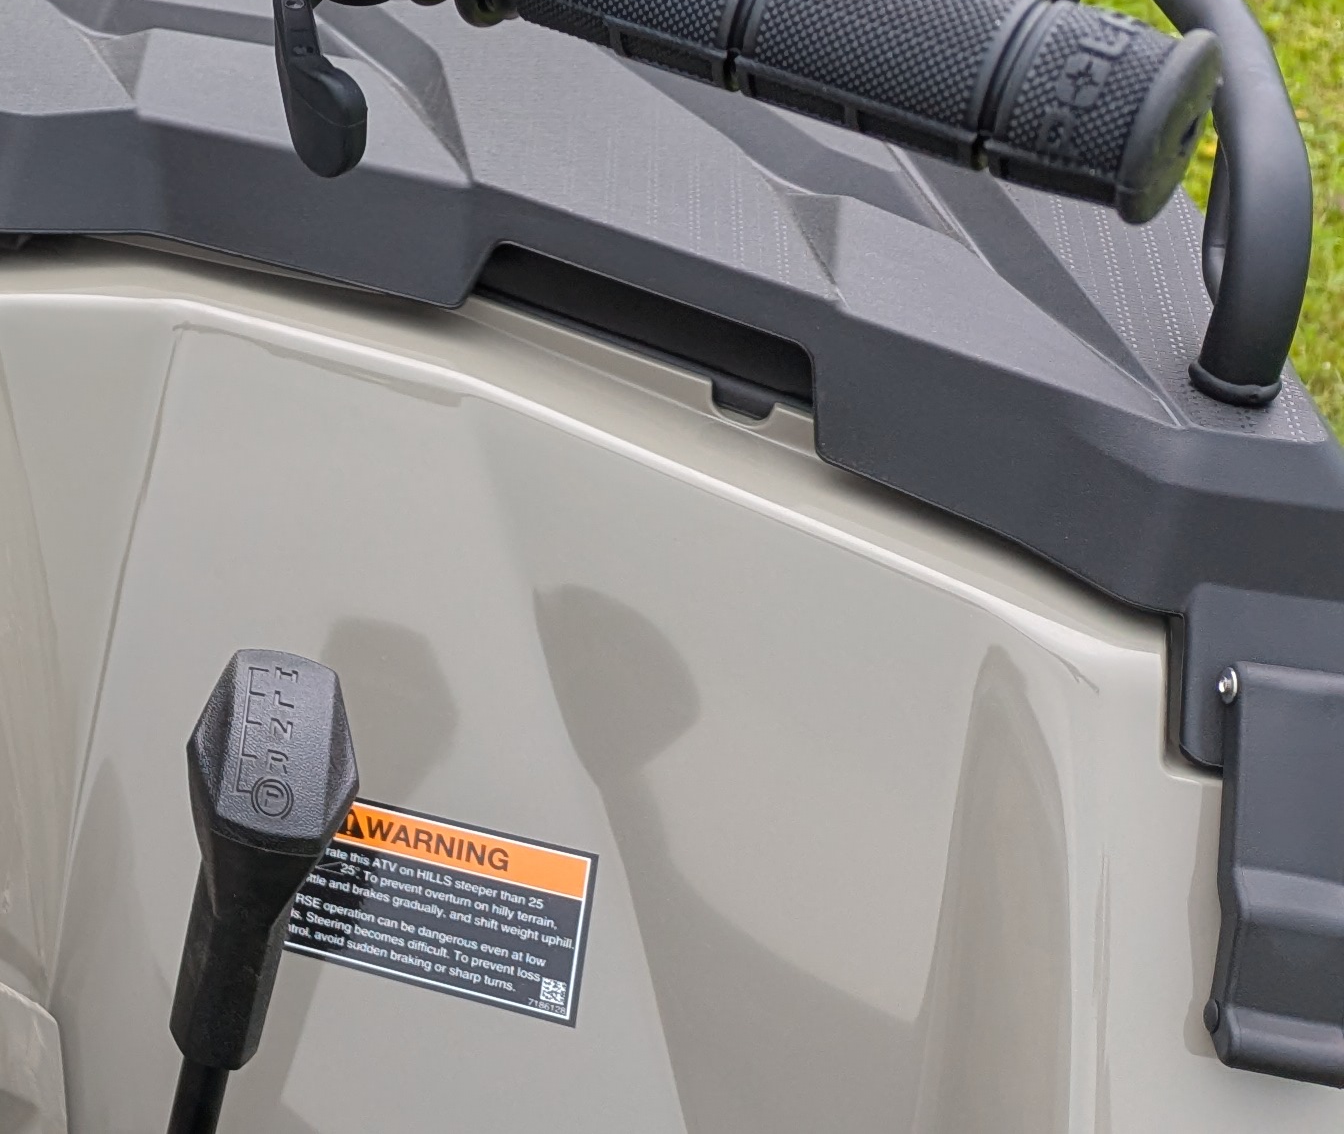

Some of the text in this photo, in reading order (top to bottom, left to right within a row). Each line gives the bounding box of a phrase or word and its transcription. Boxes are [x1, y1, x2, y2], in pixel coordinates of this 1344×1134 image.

[273, 690, 295, 709] L
[275, 666, 299, 683] H
[270, 717, 294, 740] N
[267, 749, 289, 774] R
[263, 784, 285, 808] P
[366, 815, 509, 872] WARNING
[349, 852, 370, 866] this
[372, 858, 398, 872] ATV
[399, 866, 414, 877] on
[416, 868, 452, 886] HILLS
[454, 880, 498, 897] steeper
[500, 890, 526, 905] than
[528, 896, 544, 909] 25
[363, 870, 379, 884] To
[379, 877, 423, 895] prevent
[424, 888, 471, 907] overturn
[473, 901, 489, 912] on
[491, 903, 515, 920] hilly
[323, 902, 376, 923] operation
[377, 916, 398, 929] can
[400, 920, 415, 933] be
[417, 926, 478, 949] dangerous
[480, 943, 509, 957] even
[511, 951, 523, 961] at
[525, 953, 546, 967] low
[328, 879, 350, 892] and
[352, 884, 390, 903] brakes
[449, 910, 472, 923] and
[474, 916, 498, 930] shift
[500, 924, 539, 940] weight
[306, 911, 353, 935] Steering
[354, 924, 405, 946] becomes
[407, 939, 449, 958] difficult.
[453, 949, 469, 963] To
[470, 957, 514, 975] prevent
[517, 967, 540, 982] loss
[314, 931, 345, 946] avoid
[347, 940, 388, 957] sudden
[389, 949, 432, 972] braking
[434, 963, 447, 973] or
[448, 967, 481, 984] sharp
[484, 975, 516, 991] turns.
